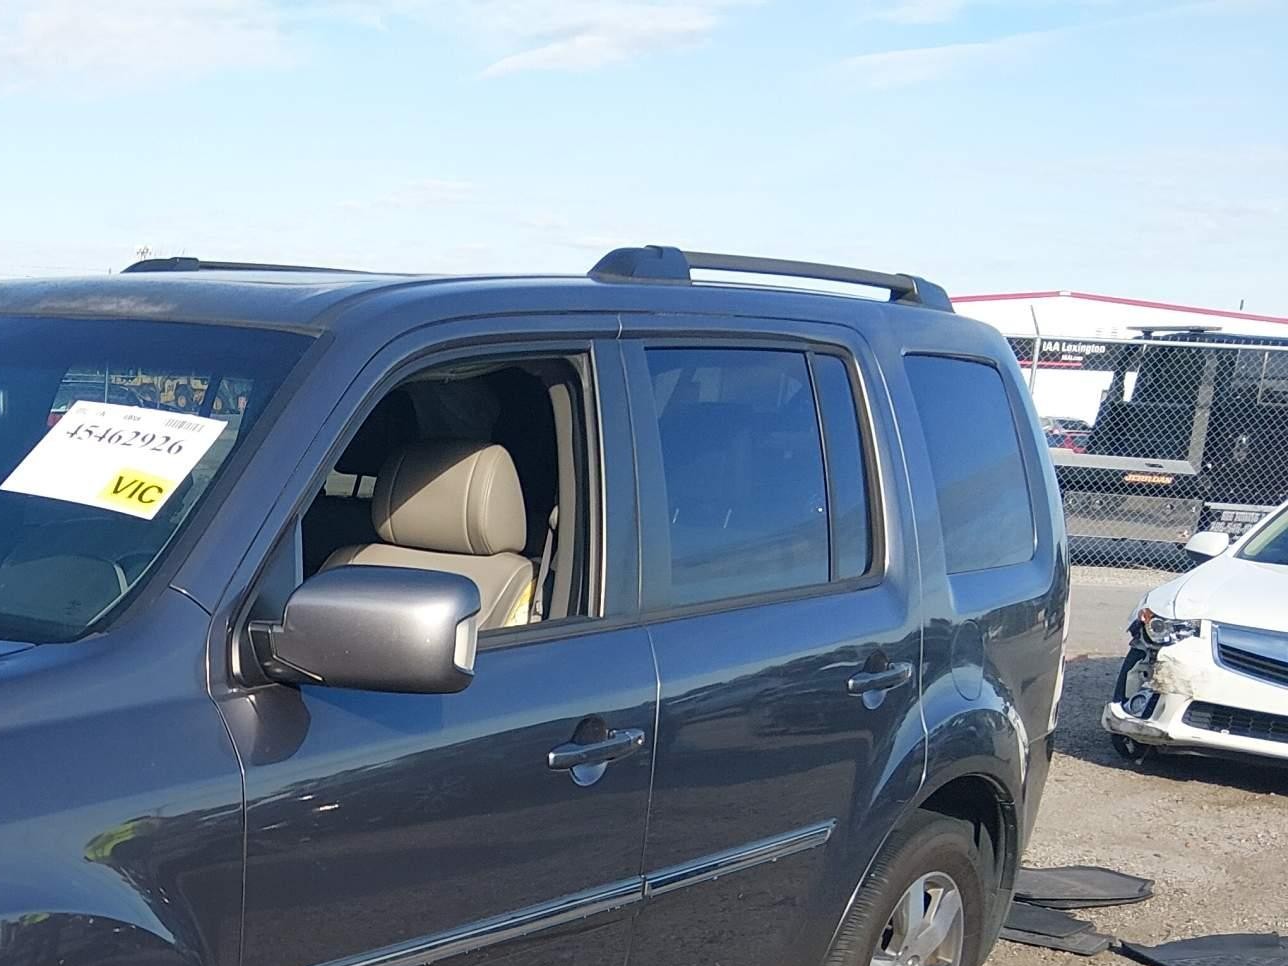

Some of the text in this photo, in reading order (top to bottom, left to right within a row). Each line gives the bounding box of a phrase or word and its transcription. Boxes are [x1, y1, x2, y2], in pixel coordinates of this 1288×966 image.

[1042, 341, 1106, 355] IAA Lexington
[66, 423, 184, 455] 45462926
[112, 475, 163, 504] VIC
